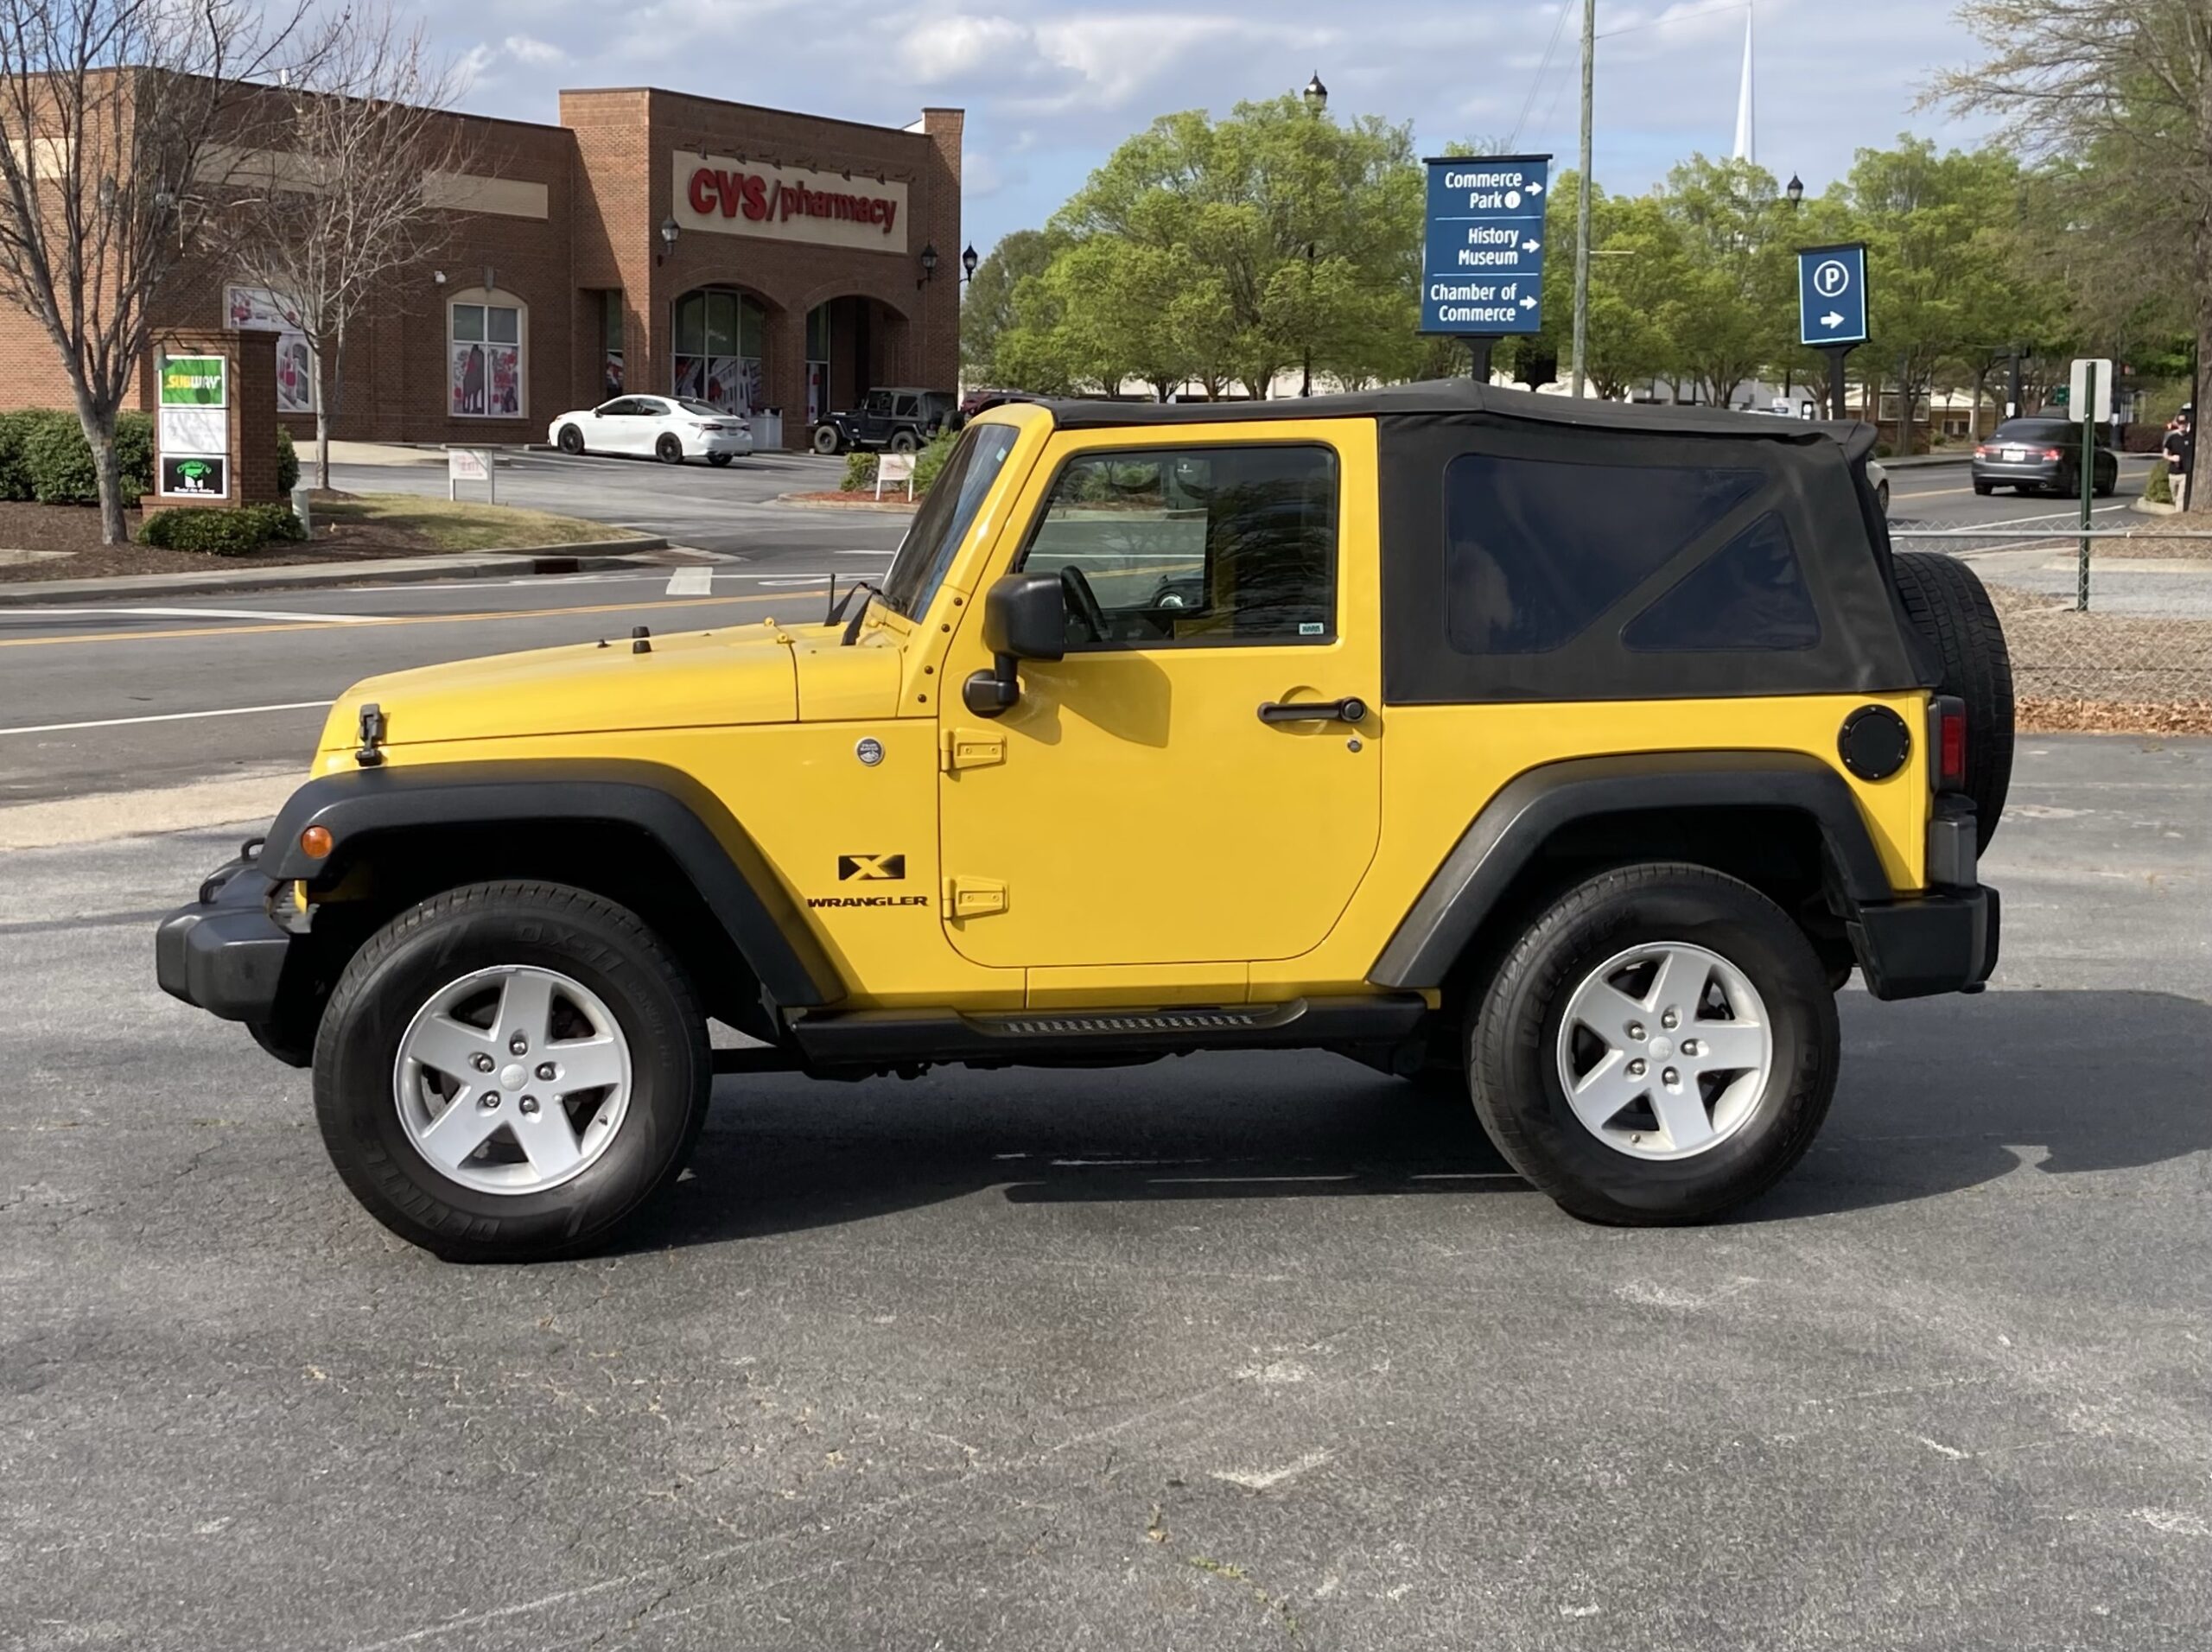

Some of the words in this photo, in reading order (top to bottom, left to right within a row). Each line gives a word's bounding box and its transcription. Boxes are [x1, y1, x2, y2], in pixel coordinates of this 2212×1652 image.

[1445, 171, 1522, 188] Commerce
[689, 168, 898, 234] CVS/pharmacy
[1470, 191, 1503, 208] Park
[1468, 226, 1519, 248] History
[1458, 249, 1518, 265] Museum
[1430, 283, 1496, 301] Chamber
[1501, 283, 1517, 301] of
[1439, 305, 1516, 321] Commerce
[166, 374, 222, 389] SUBWAY
[806, 896, 929, 908] WRANGLER
